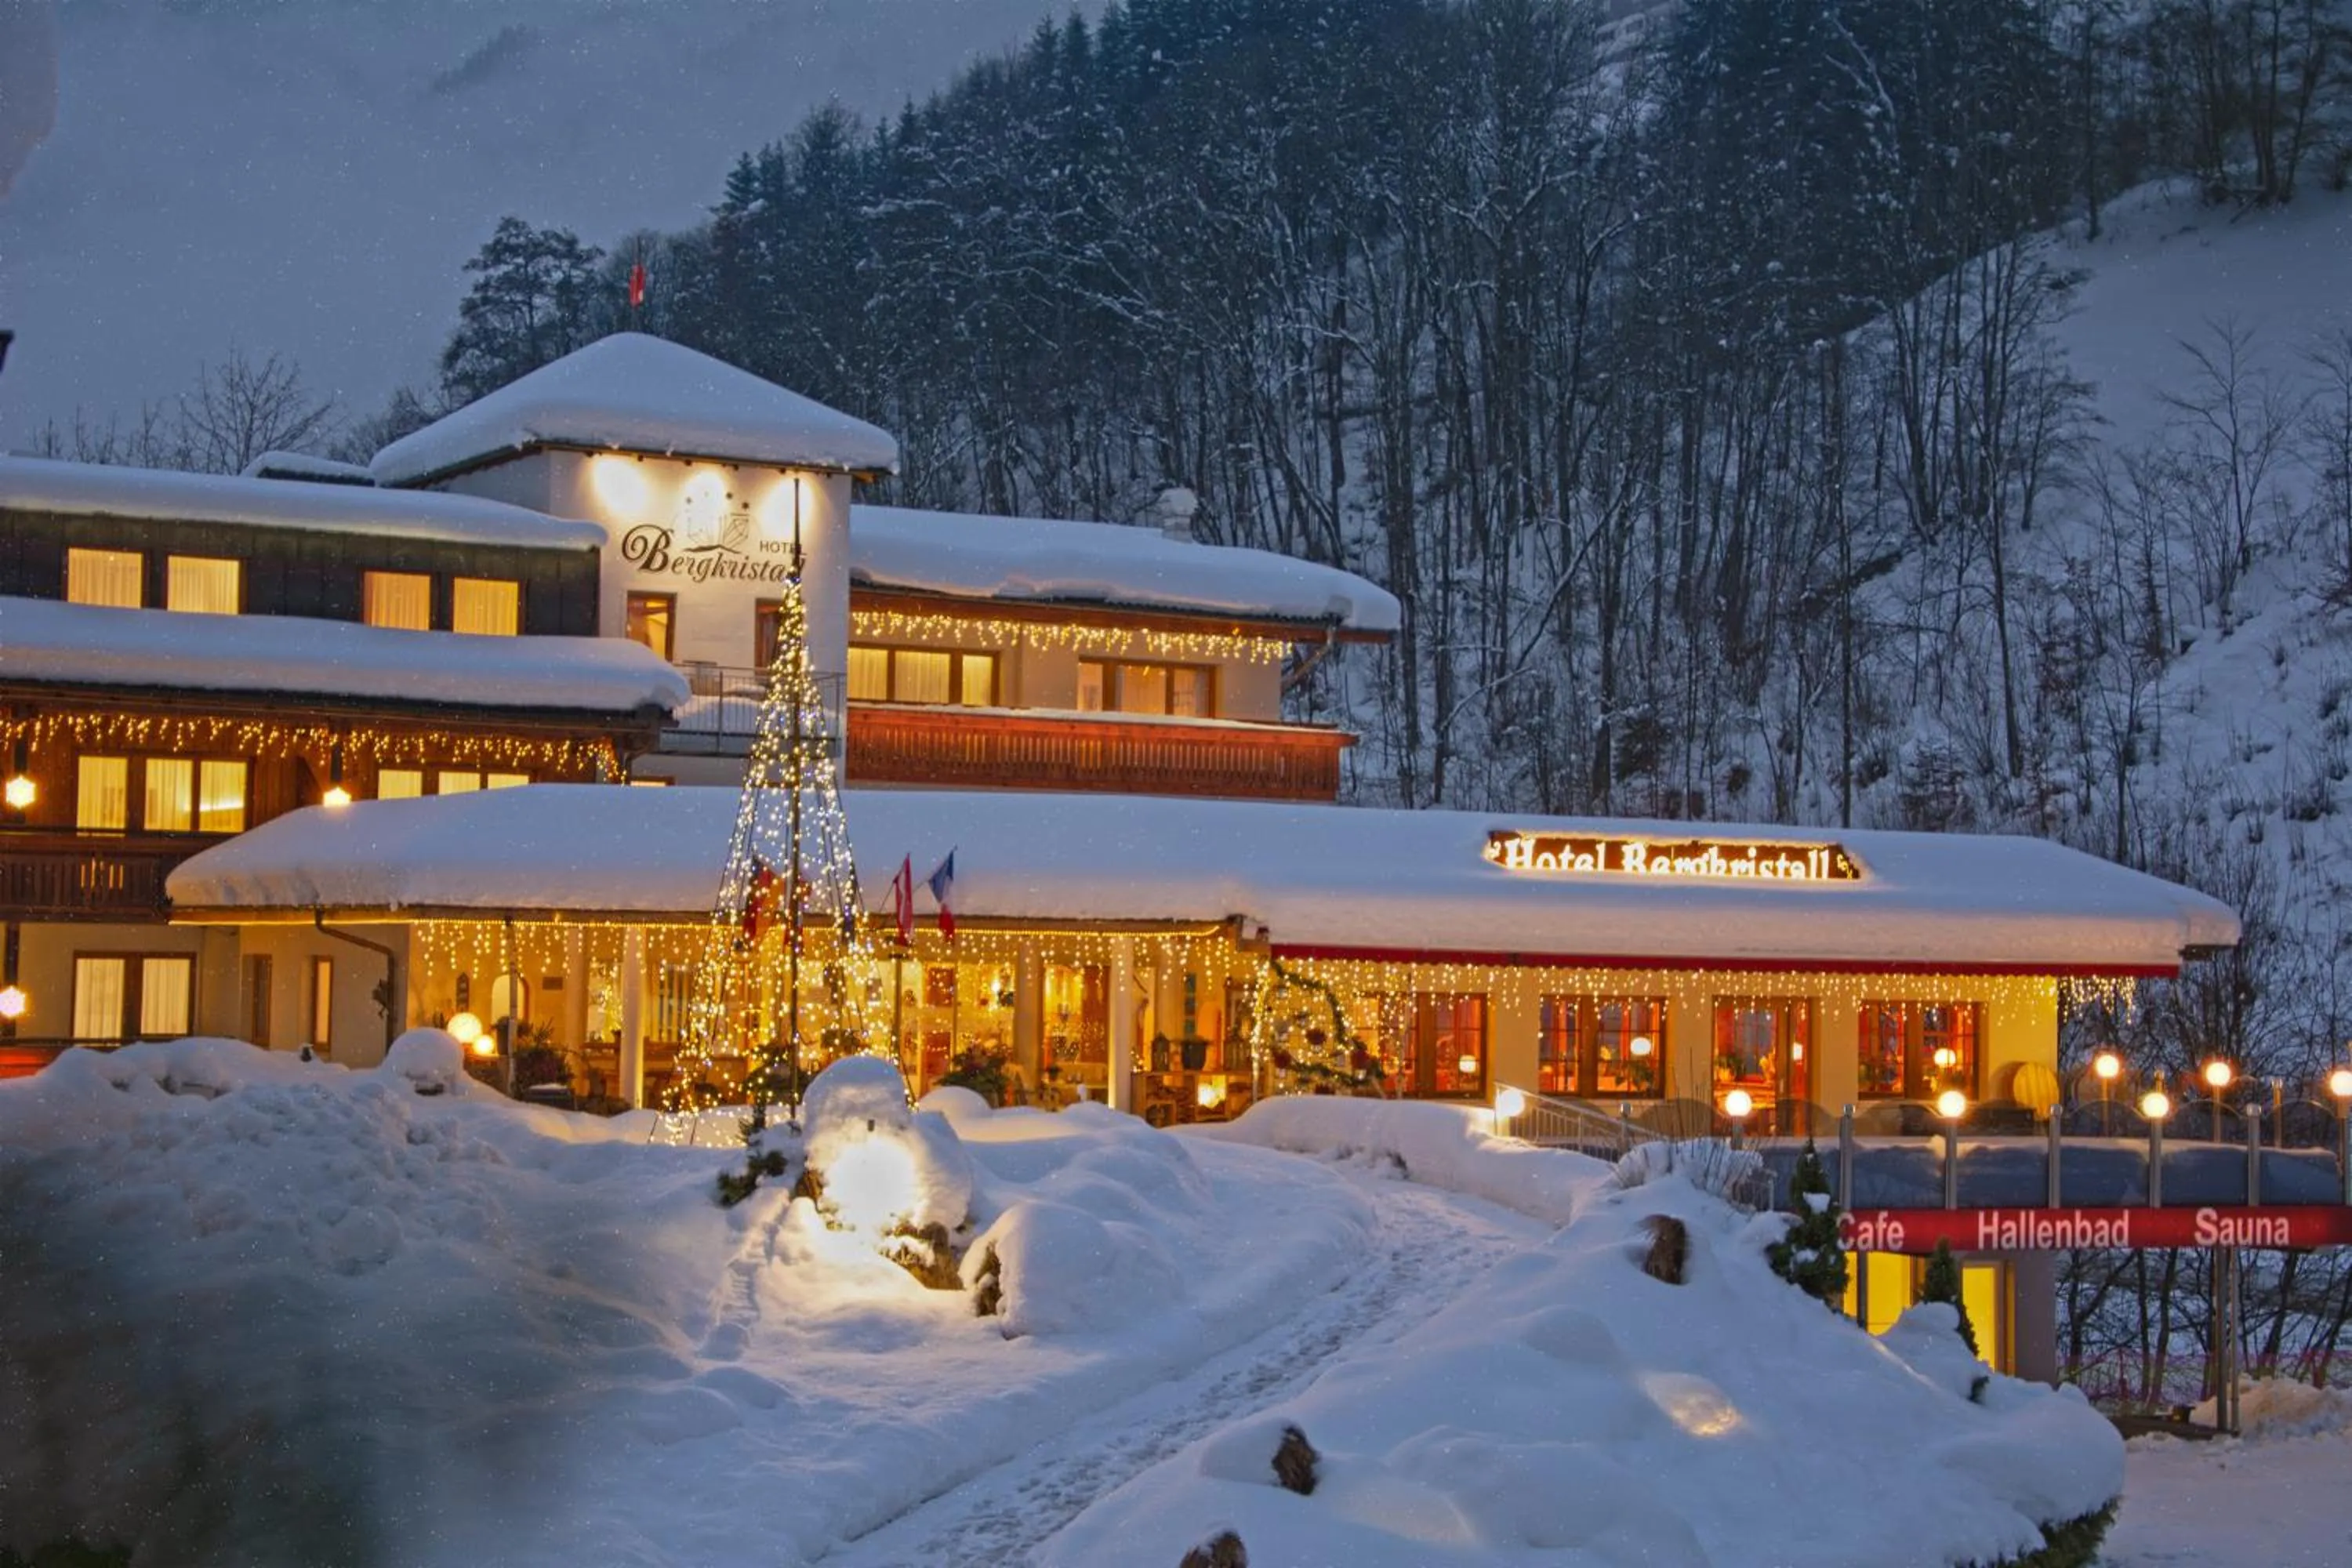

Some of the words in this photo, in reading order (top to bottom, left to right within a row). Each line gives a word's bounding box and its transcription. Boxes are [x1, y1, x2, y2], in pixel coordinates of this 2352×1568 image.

[759, 540, 807, 555] HOTE
[1504, 837, 1606, 872] Hotel
[1836, 1210, 1904, 1250] Cafe
[1978, 1209, 2129, 1250] Hallenbad
[2194, 1207, 2289, 1246] Sauna
